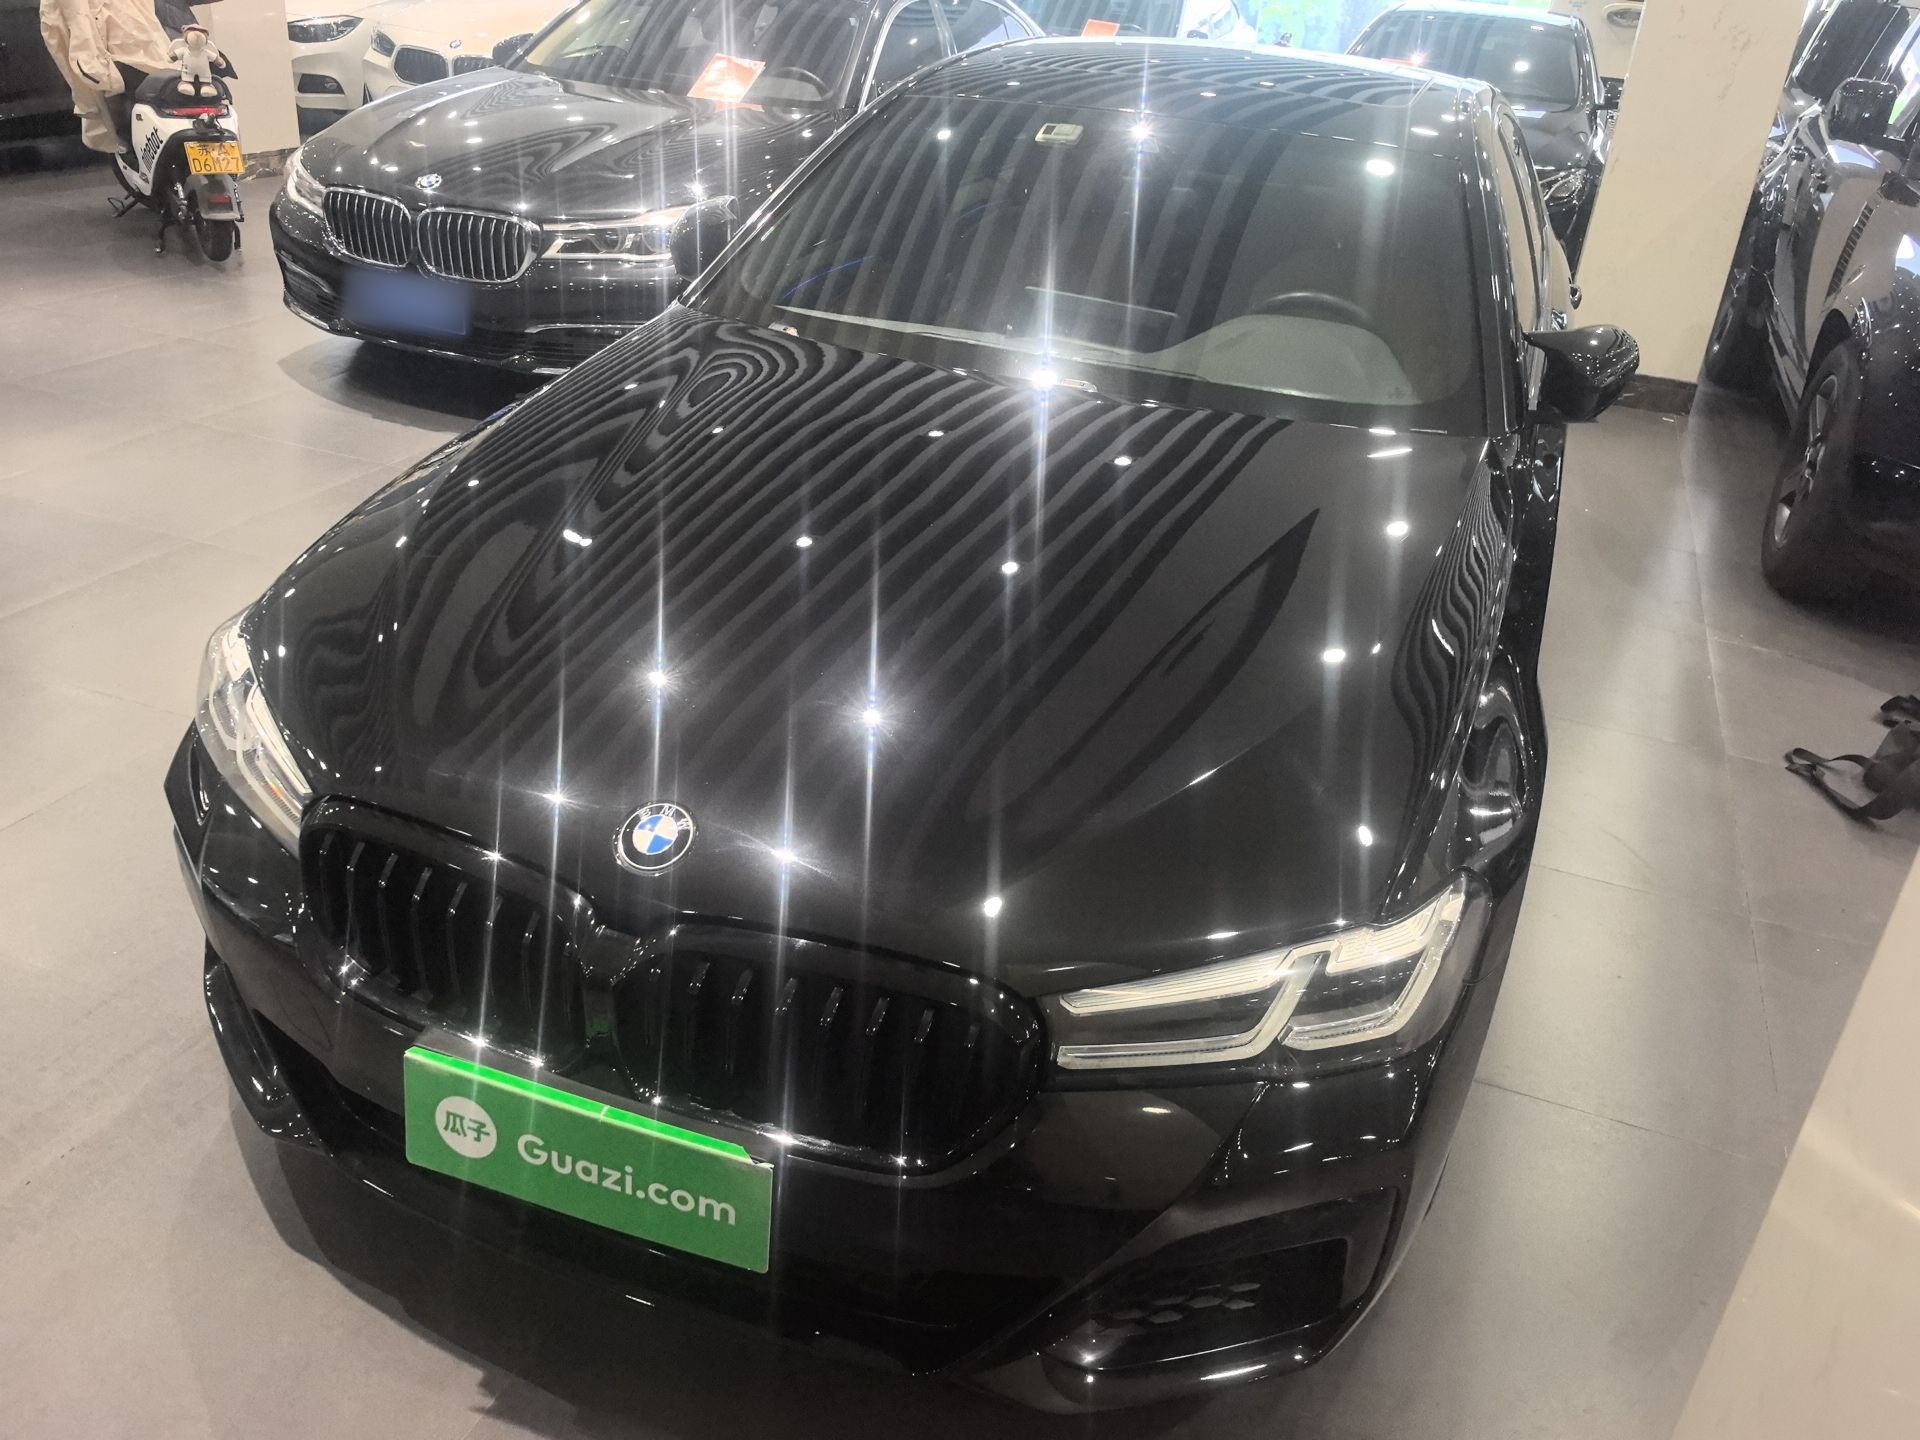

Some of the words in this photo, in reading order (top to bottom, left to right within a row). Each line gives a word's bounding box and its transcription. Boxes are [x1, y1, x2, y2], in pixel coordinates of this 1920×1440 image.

[638, 804, 691, 831] BMW
[443, 1110, 491, 1143] 瓜子
[517, 1134, 736, 1226] Guazi.com
